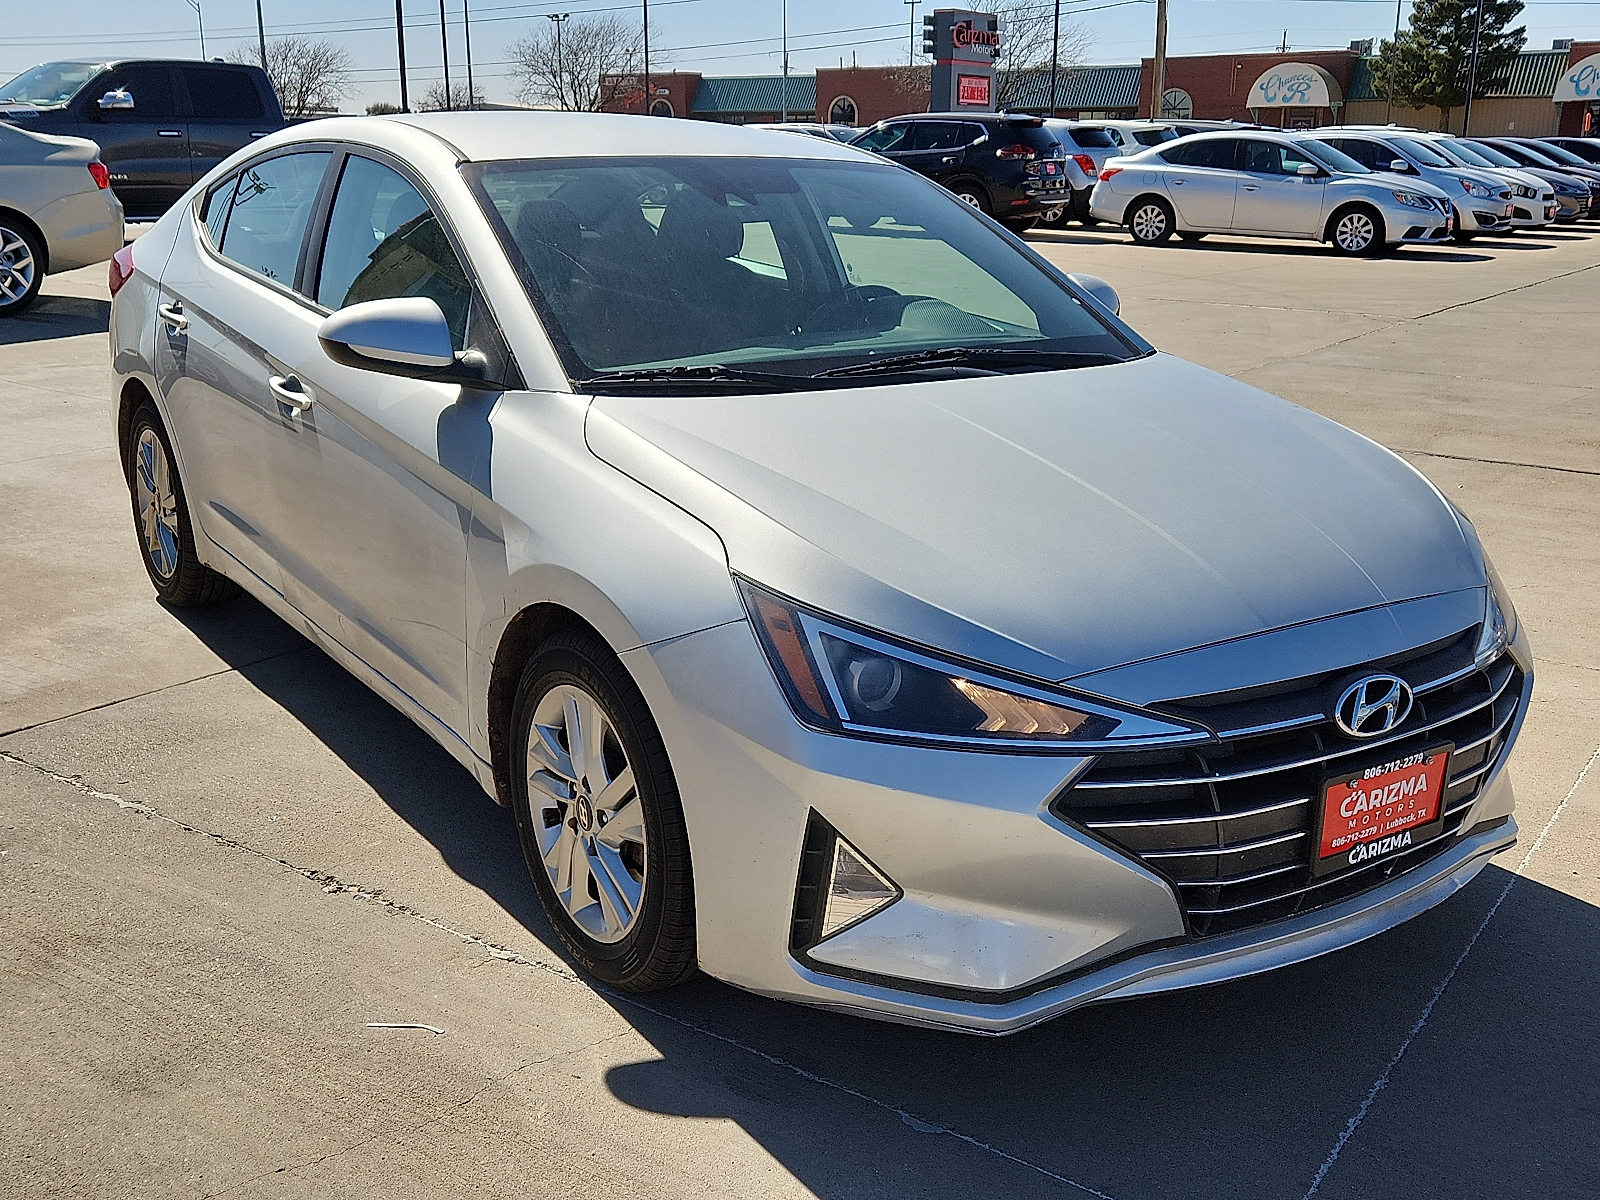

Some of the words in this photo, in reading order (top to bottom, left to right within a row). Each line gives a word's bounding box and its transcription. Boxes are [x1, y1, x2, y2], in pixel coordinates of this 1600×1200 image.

[953, 19, 998, 48] Carizma
[971, 44, 994, 55] Motors
[1259, 74, 1318, 103] Chances
[1282, 82, 1312, 104] R
[1363, 753, 1424, 780] 806-712-2279
[1340, 773, 1428, 818] CARIZMA
[1331, 825, 1378, 848] 806-712-2279
[1386, 812, 1417, 830] Lubbock,
[1417, 808, 1427, 818] TX
[1348, 799, 1415, 829] MOTORS
[1348, 831, 1412, 865] CARIZMA
